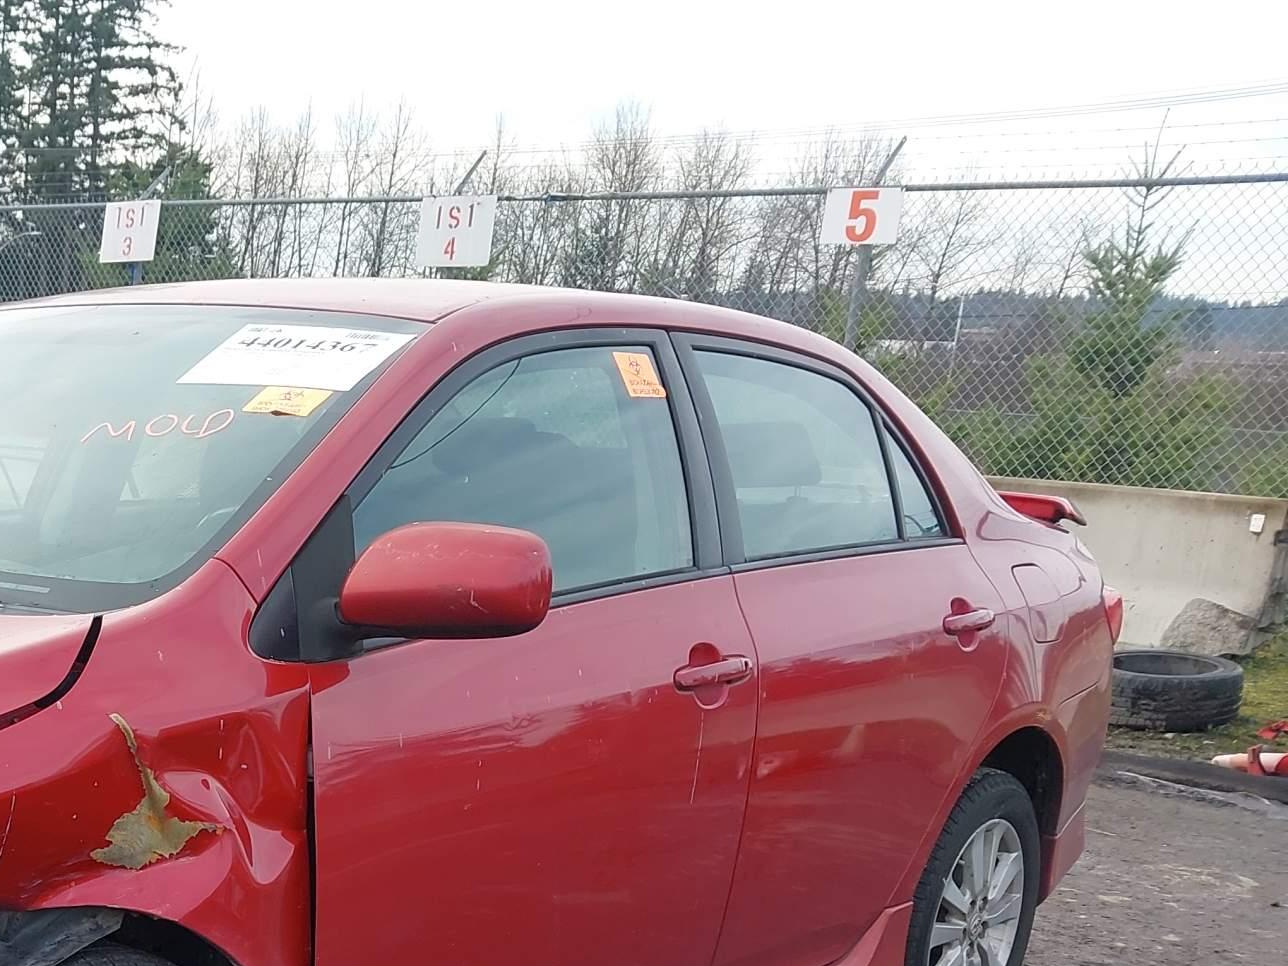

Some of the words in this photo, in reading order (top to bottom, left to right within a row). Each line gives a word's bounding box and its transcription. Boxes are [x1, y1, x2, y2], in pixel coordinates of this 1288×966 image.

[844, 189, 881, 243] 5
[122, 236, 132, 257] 3
[443, 236, 456, 261] 4
[237, 335, 379, 353] 44014367
